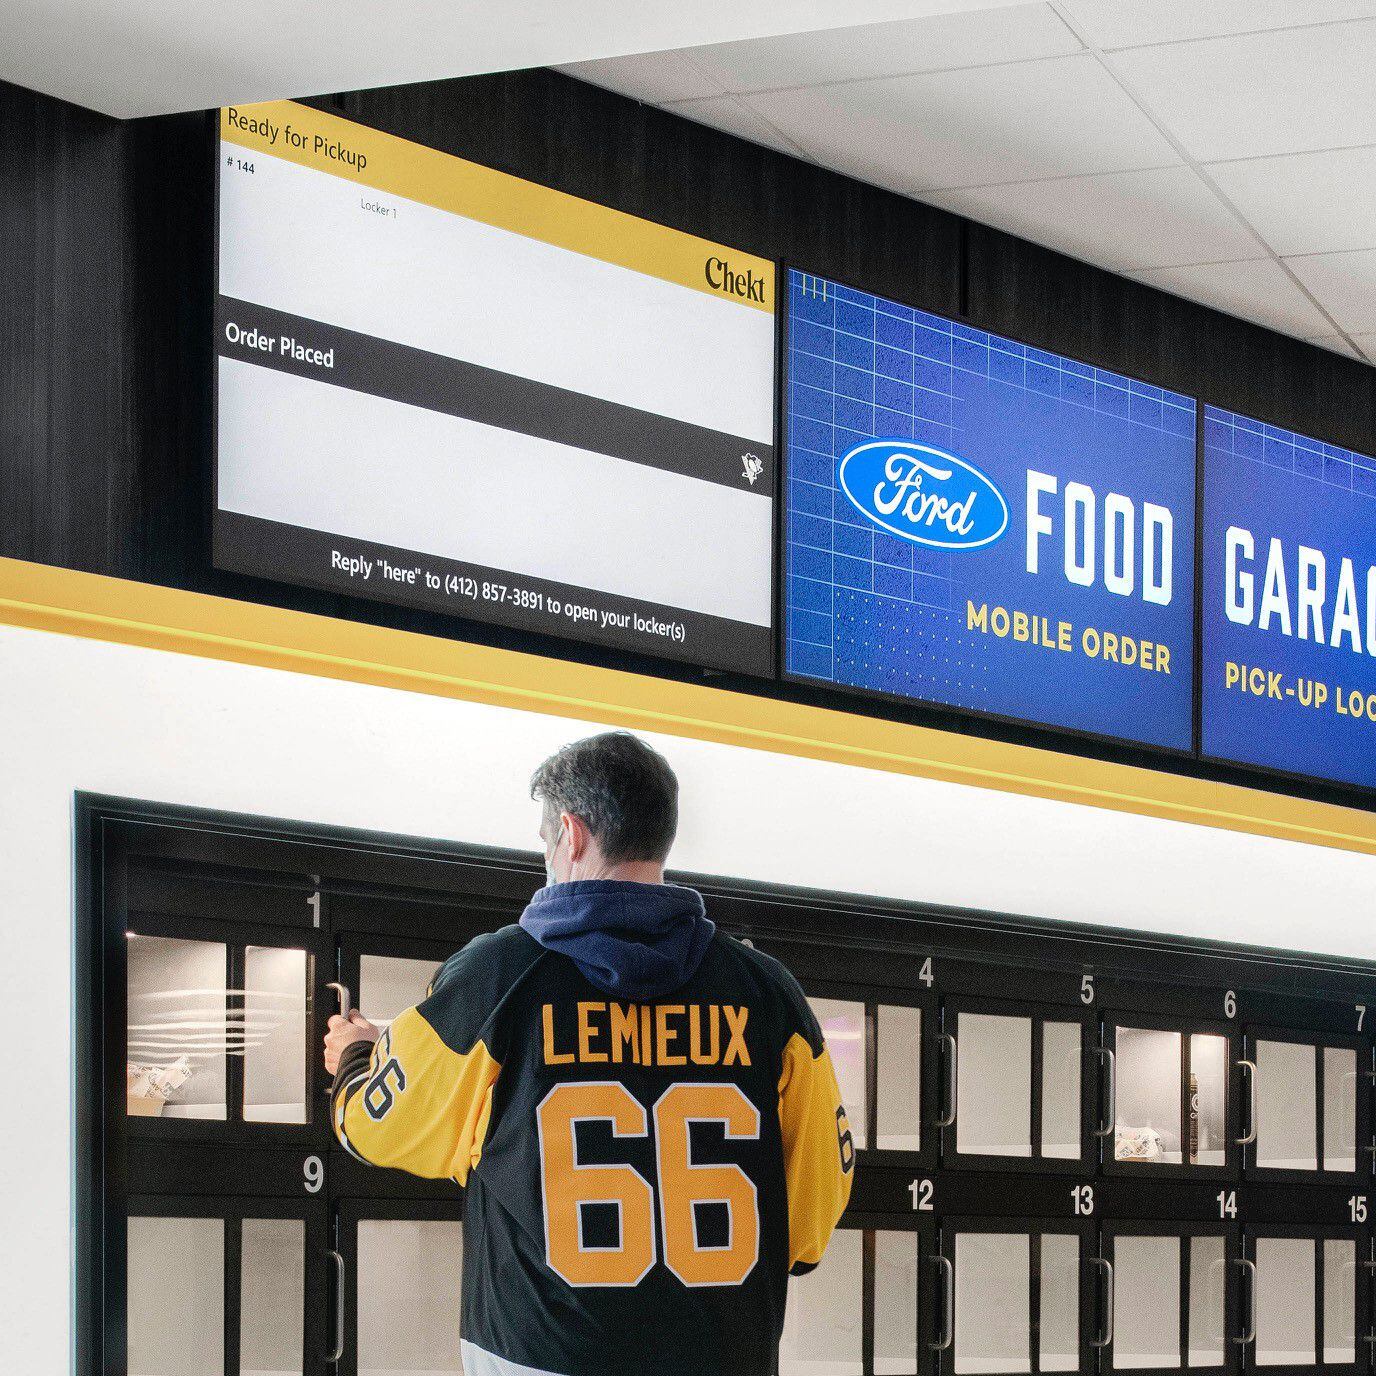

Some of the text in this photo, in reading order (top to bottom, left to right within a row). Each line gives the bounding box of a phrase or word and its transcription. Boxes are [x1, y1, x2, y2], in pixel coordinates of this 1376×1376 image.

[228, 107, 367, 172] Ready for Pickup
[227, 157, 254, 174] # 144
[361, 198, 396, 218] Locker 1
[705, 256, 765, 304] Chekt
[225, 323, 334, 368] Order Placed
[874, 452, 977, 536] Ford
[1026, 469, 1172, 607] FOOD
[332, 550, 685, 642] Reply "here" to (412) 857-3891 to open your locker(s)
[967, 600, 1072, 652] MOBILE
[1083, 628, 1171, 674] ORDER
[1225, 661, 1327, 709] PICK-UP
[306, 893, 321, 927] 1
[919, 958, 934, 987] 4
[1081, 975, 1094, 1004] 5
[1224, 990, 1236, 1018] 6
[1356, 1005, 1366, 1032] 7
[543, 1002, 752, 1067] LEMIEUX
[303, 1156, 323, 1193] 9
[537, 1081, 760, 1287] 66
[909, 1180, 934, 1211] 12
[1071, 1185, 1094, 1215] 13
[1216, 1190, 1238, 1219] 14
[1349, 1195, 1367, 1222] 15
